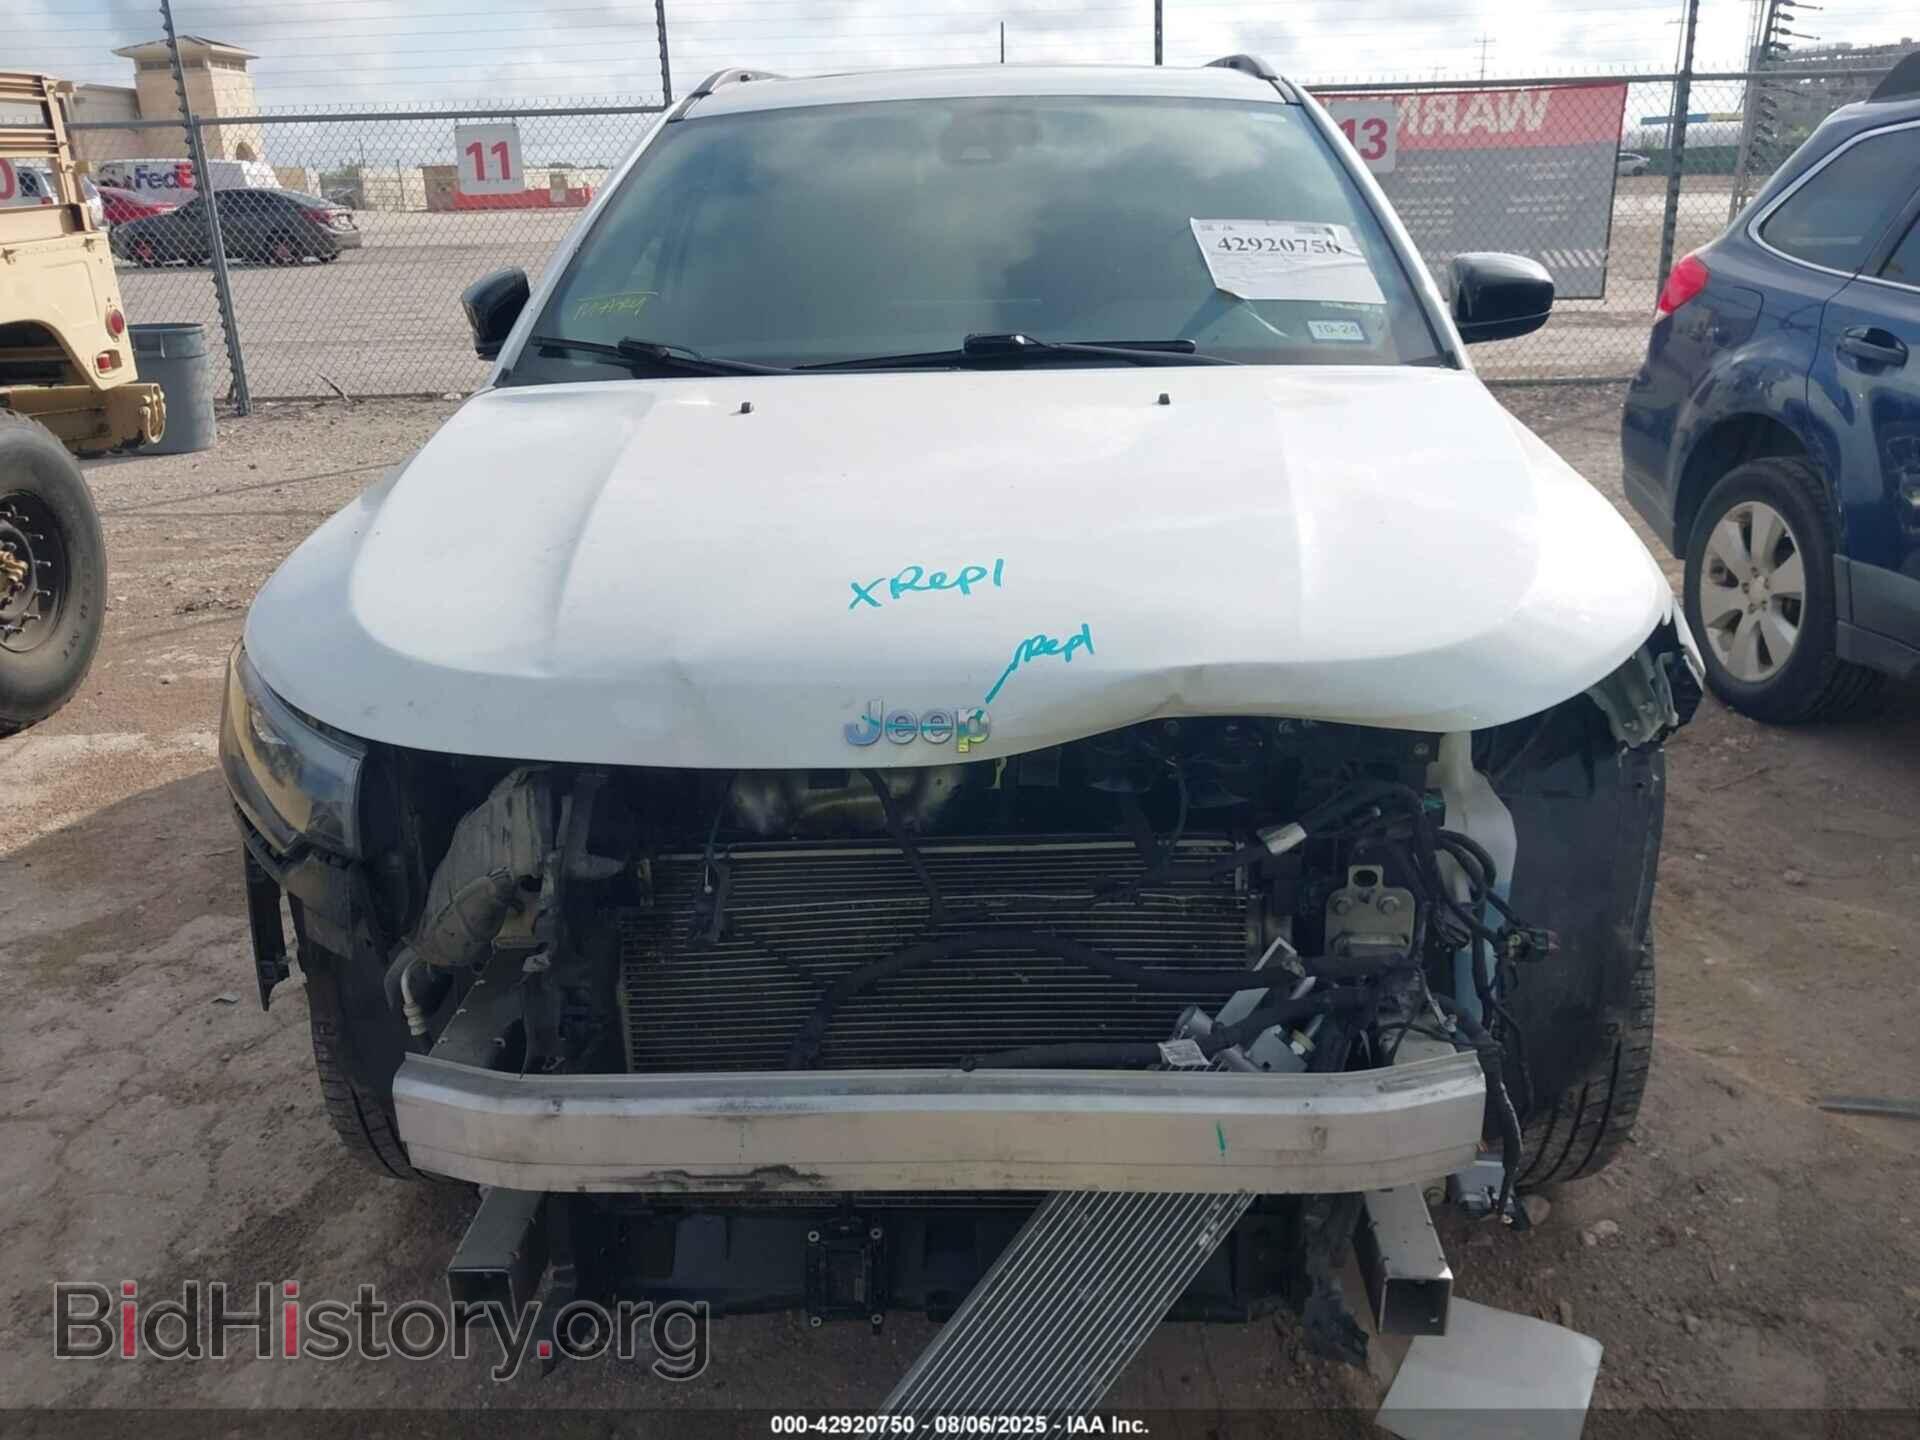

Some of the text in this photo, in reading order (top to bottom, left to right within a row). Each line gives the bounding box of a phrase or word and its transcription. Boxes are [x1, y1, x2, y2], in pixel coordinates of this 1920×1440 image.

[135, 165, 193, 189] FedE
[465, 141, 511, 181] 11
[845, 699, 991, 753] Jeep
